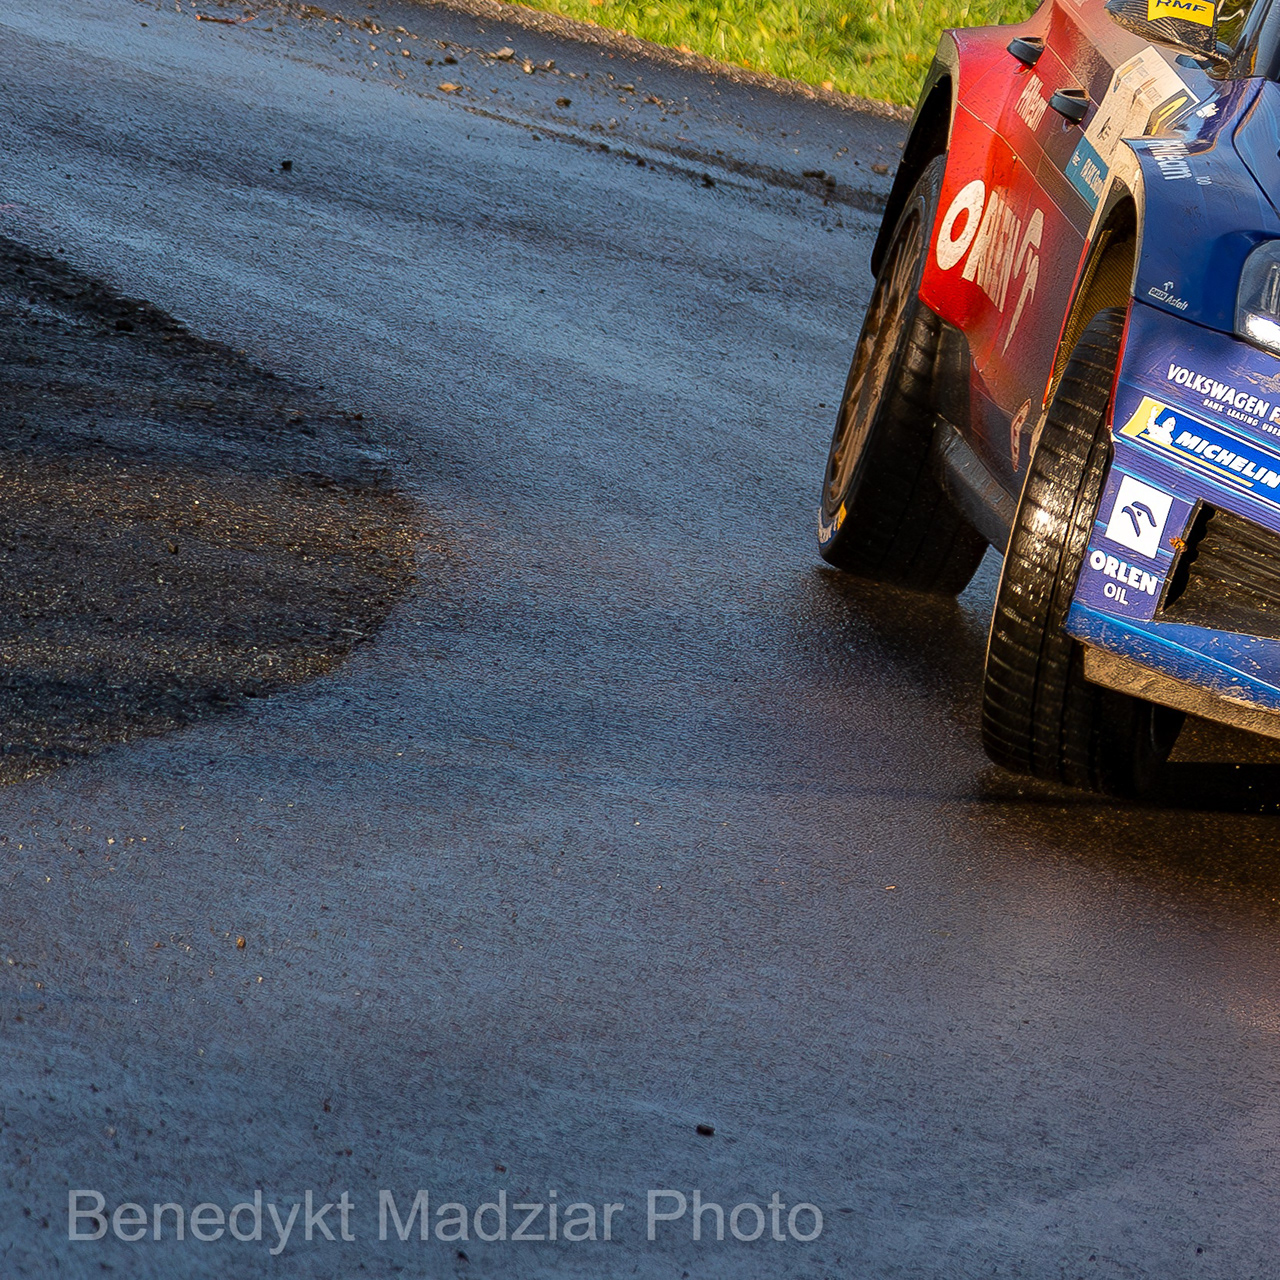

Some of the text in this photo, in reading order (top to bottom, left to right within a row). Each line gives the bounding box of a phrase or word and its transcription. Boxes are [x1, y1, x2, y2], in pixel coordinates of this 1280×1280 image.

[1167, 363, 1272, 419] VOLKSWAGEN
[1203, 399, 1225, 413] BANK
[1227, 408, 1259, 428] LEASING
[1090, 550, 1159, 596] ORLEN
[1103, 582, 1129, 606] OIL
